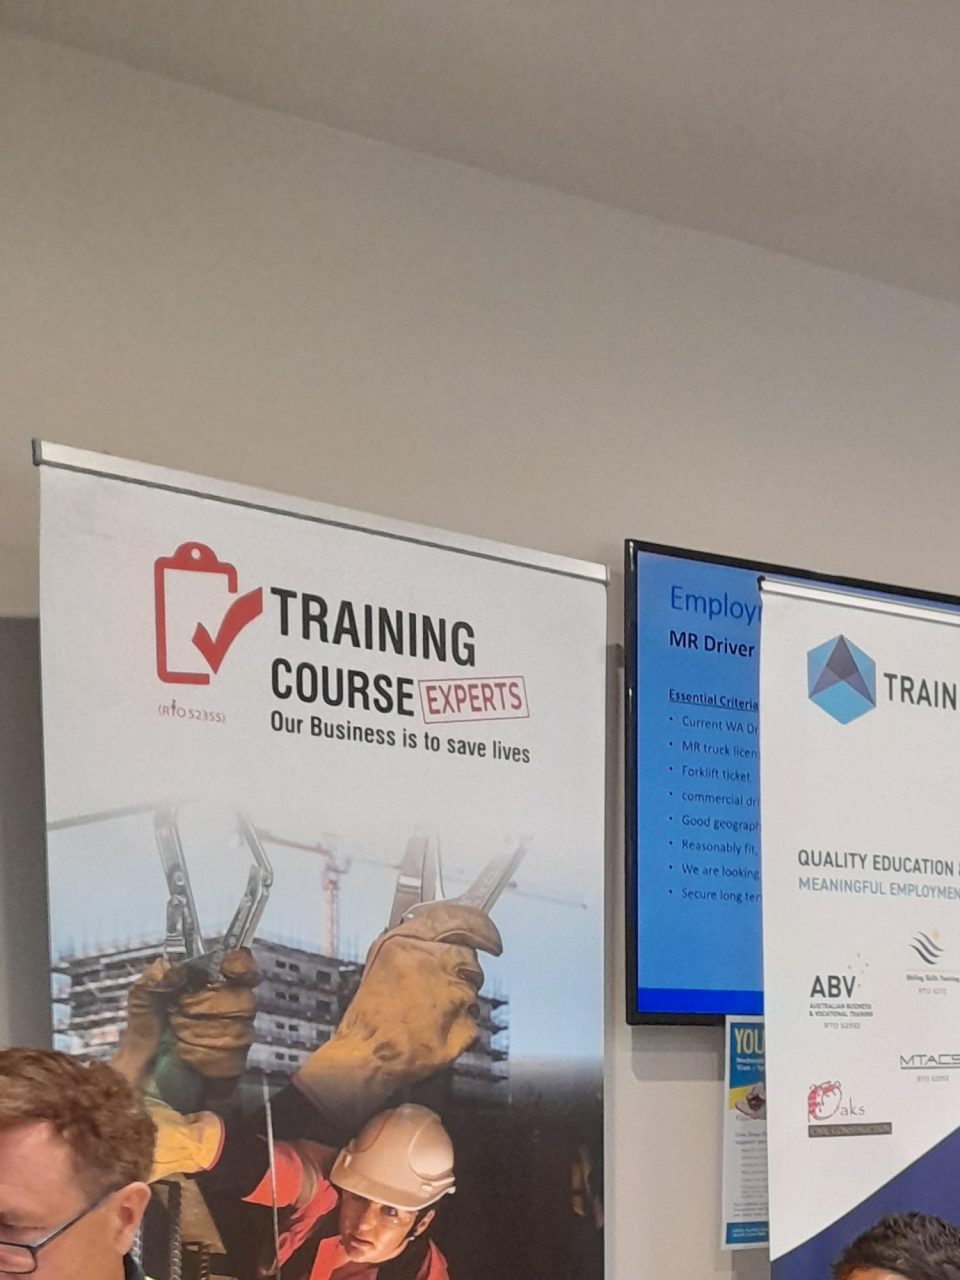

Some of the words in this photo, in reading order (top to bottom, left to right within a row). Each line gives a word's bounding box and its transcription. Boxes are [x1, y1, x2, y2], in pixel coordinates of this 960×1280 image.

[670, 585, 761, 626] Employ
[270, 586, 476, 667] TRAINING
[669, 629, 698, 649] MR
[704, 635, 755, 658] Driver
[271, 657, 415, 717] COURSE
[425, 681, 523, 715] EXPERTS
[668, 688, 717, 706] Essential
[682, 715, 722, 731] Current
[725, 720, 744, 733] WA
[270, 710, 304, 734] Our
[310, 716, 396, 746] Business
[402, 728, 418, 748] is
[424, 731, 440, 752] to
[446, 738, 486, 758] save
[492, 740, 531, 764] lives
[682, 740, 700, 753] MR
[703, 744, 730, 756] truck
[682, 764, 719, 779] Forklift
[722, 770, 751, 783] ticket
[682, 814, 711, 827] Good
[682, 839, 741, 856] Reasonably
[682, 863, 699, 876] We
[702, 866, 719, 877] are
[722, 866, 760, 882] looking
[797, 849, 869, 870] QUALITY
[872, 854, 954, 877] EDUCATION
[798, 876, 887, 896] MEANINGFUL
[682, 888, 717, 900] Secure
[720, 888, 743, 904] long
[809, 975, 856, 999] ABV
